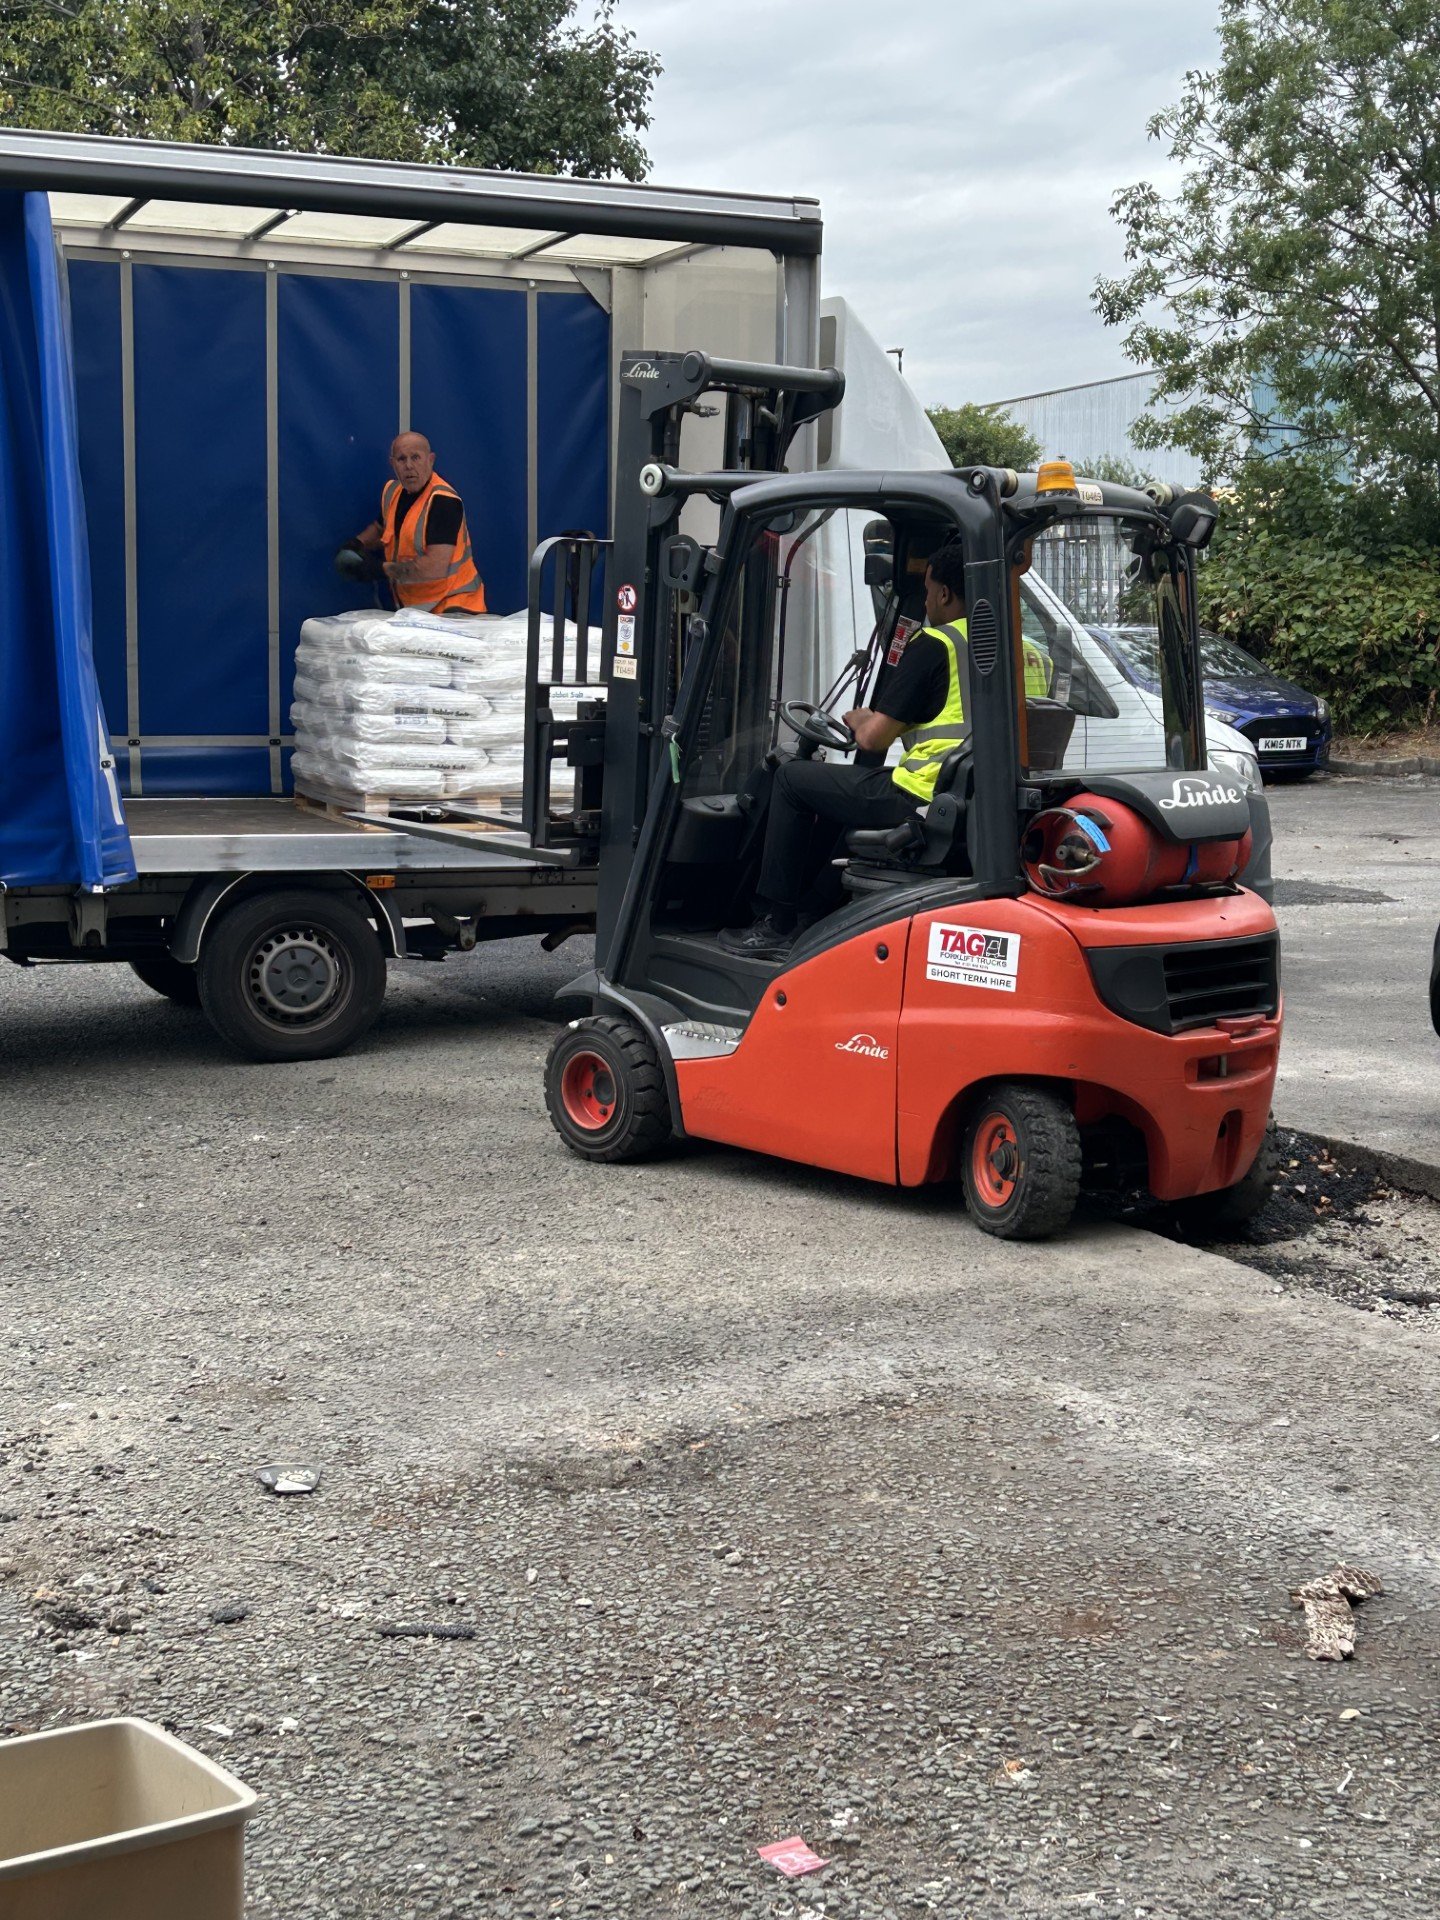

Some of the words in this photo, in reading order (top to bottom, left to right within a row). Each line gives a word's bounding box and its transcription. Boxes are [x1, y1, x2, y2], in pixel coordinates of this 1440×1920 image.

[622, 362, 660, 378] Linde
[1264, 740, 1284, 749] KM15
[1285, 739, 1302, 749] NTK
[1159, 778, 1241, 809] Linde
[940, 928, 985, 957] TAG
[940, 951, 974, 963] FORKLIFT
[974, 957, 1007, 968] TRUCKS
[931, 968, 961, 980] SHORT
[963, 973, 987, 984] TERM
[990, 978, 1012, 988] HIRE
[835, 1033, 889, 1059] Linde
